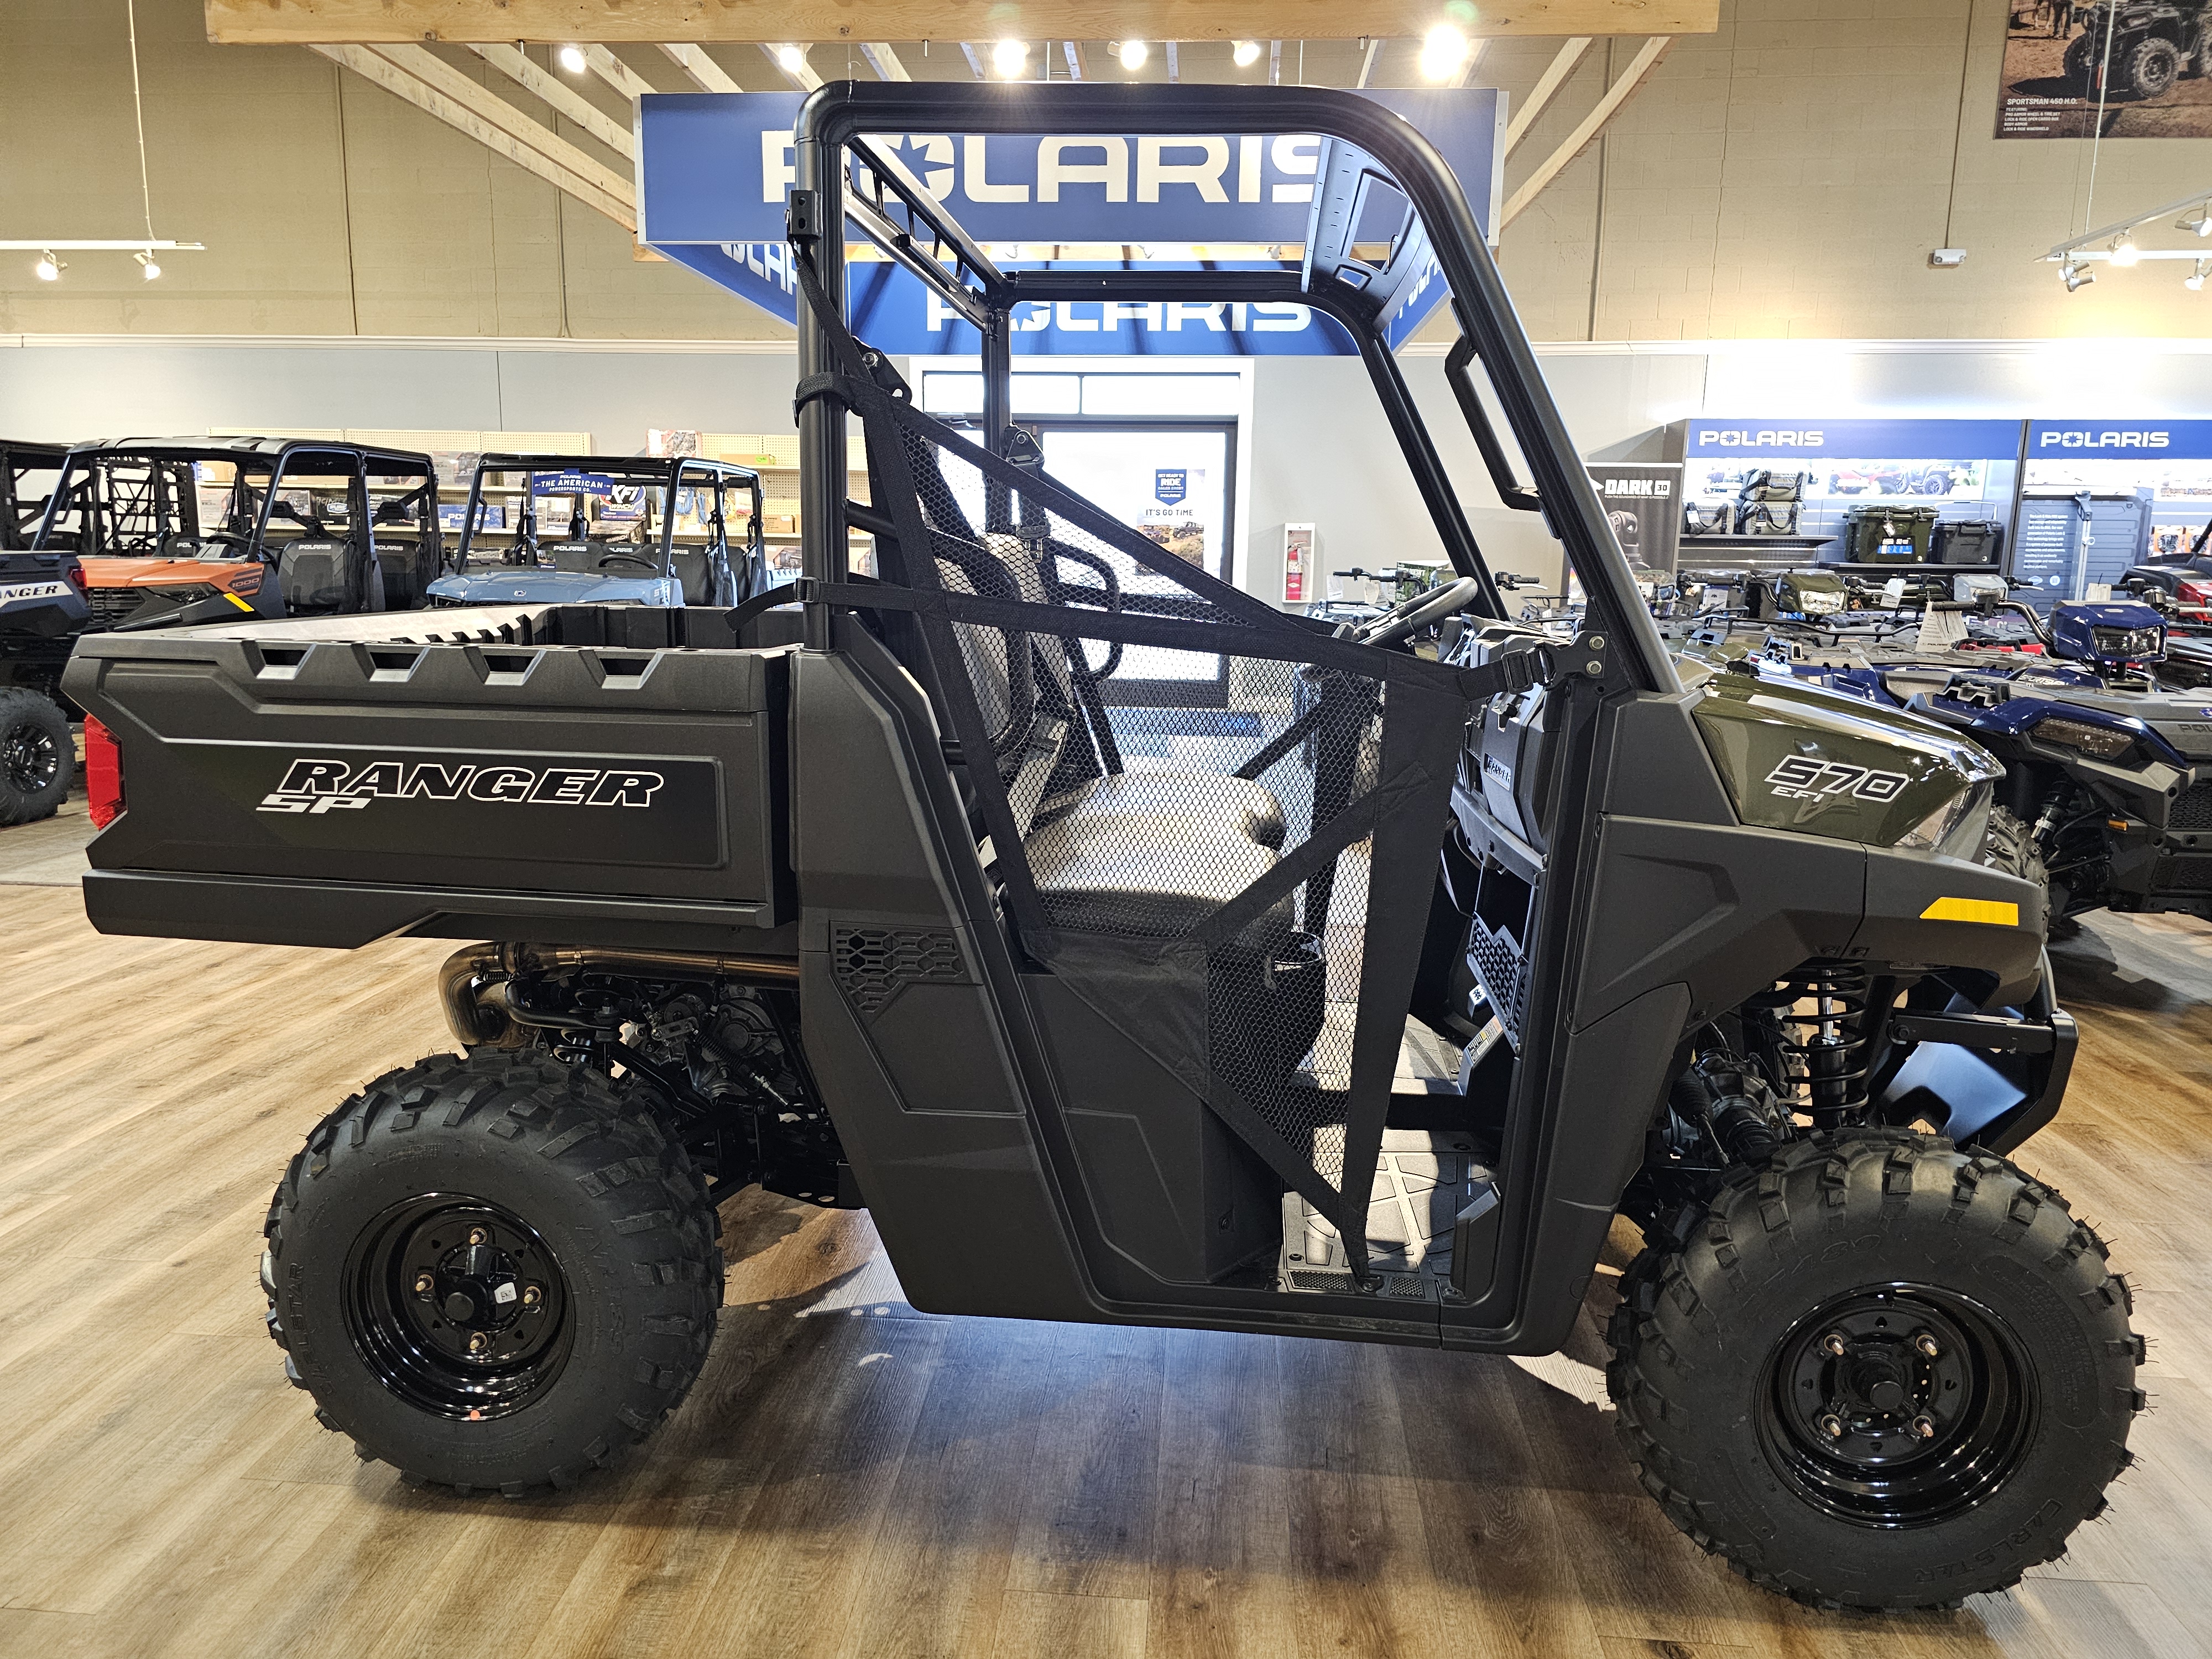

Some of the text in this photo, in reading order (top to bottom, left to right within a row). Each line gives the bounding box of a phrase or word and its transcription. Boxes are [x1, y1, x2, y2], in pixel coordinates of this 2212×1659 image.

[1699, 430, 1824, 446] POLARIS
[2041, 431, 2169, 447] POLARIS
[557, 479, 603, 488] AMERICAN
[1161, 478, 1181, 486] RIDE
[1604, 479, 1653, 495] DARK
[232, 578, 260, 588] 1000
[0, 585, 58, 599] NGER
[276, 759, 665, 807] RANGER
[1764, 754, 1910, 802] 570
[1770, 786, 1824, 802] EFI
[255, 793, 372, 814] SP
